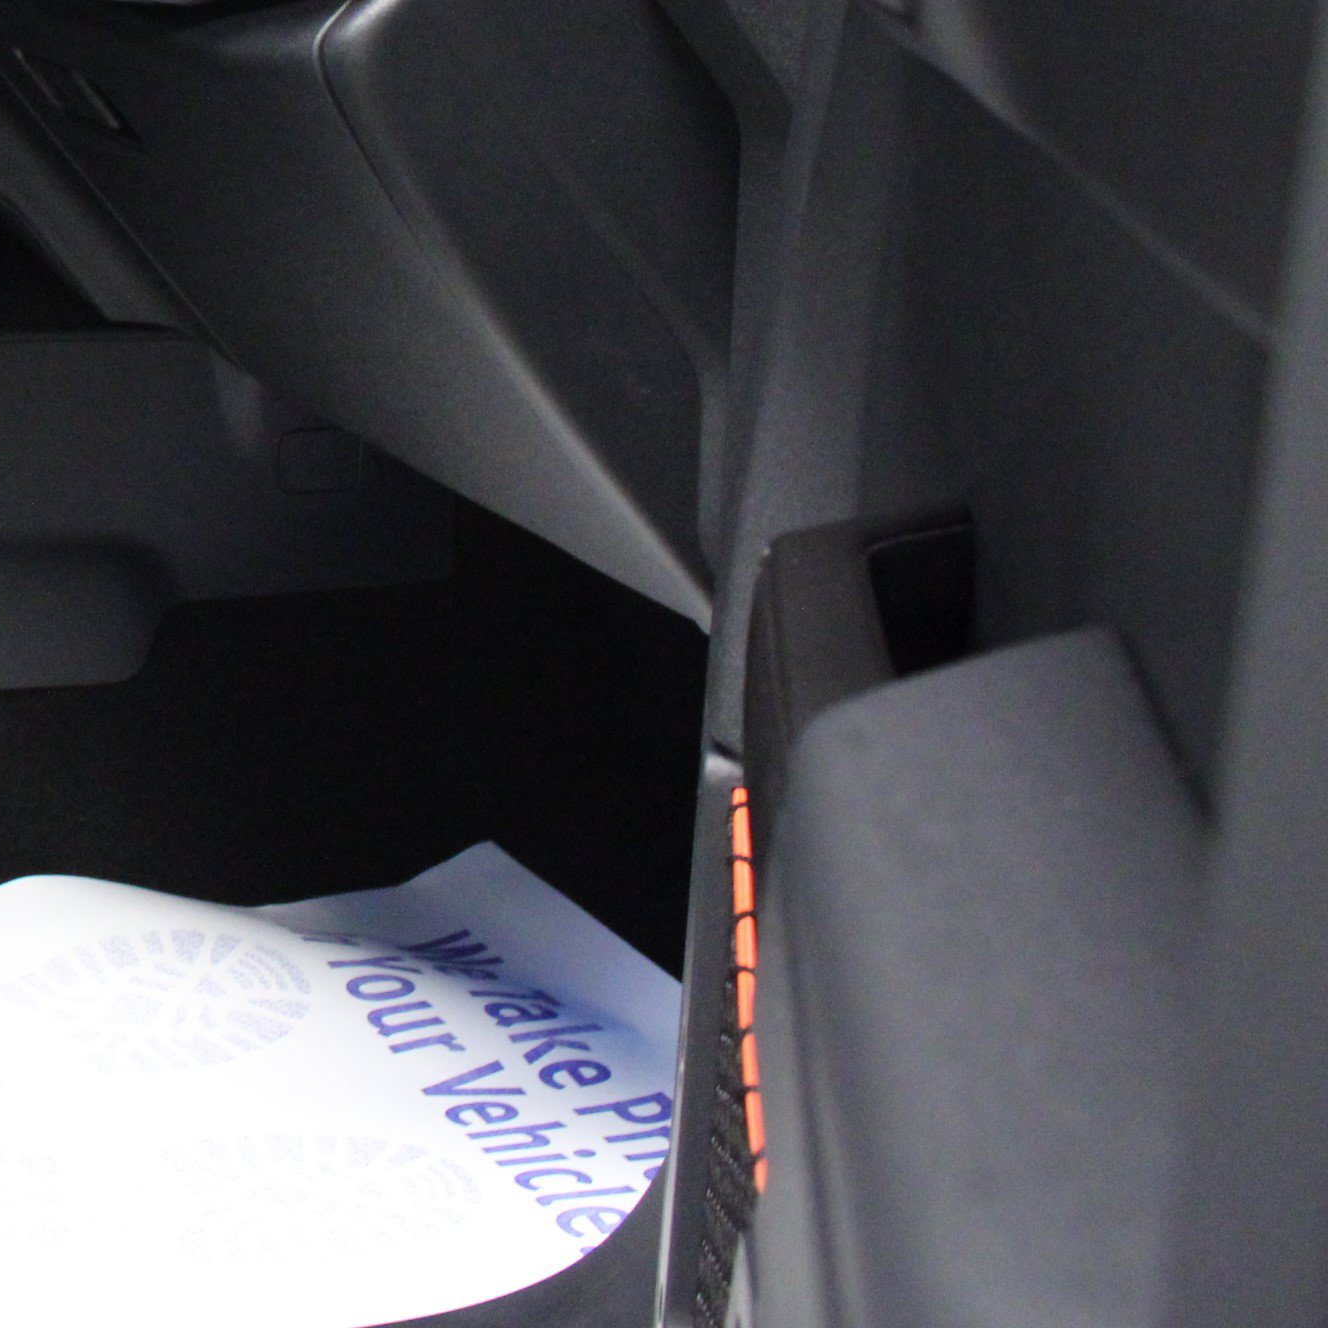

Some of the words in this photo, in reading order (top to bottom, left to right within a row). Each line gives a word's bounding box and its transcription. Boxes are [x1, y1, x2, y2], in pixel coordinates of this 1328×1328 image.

[327, 955, 466, 1054] Your
[469, 988, 612, 1090] Take
[573, 1091, 673, 1182] Pri
